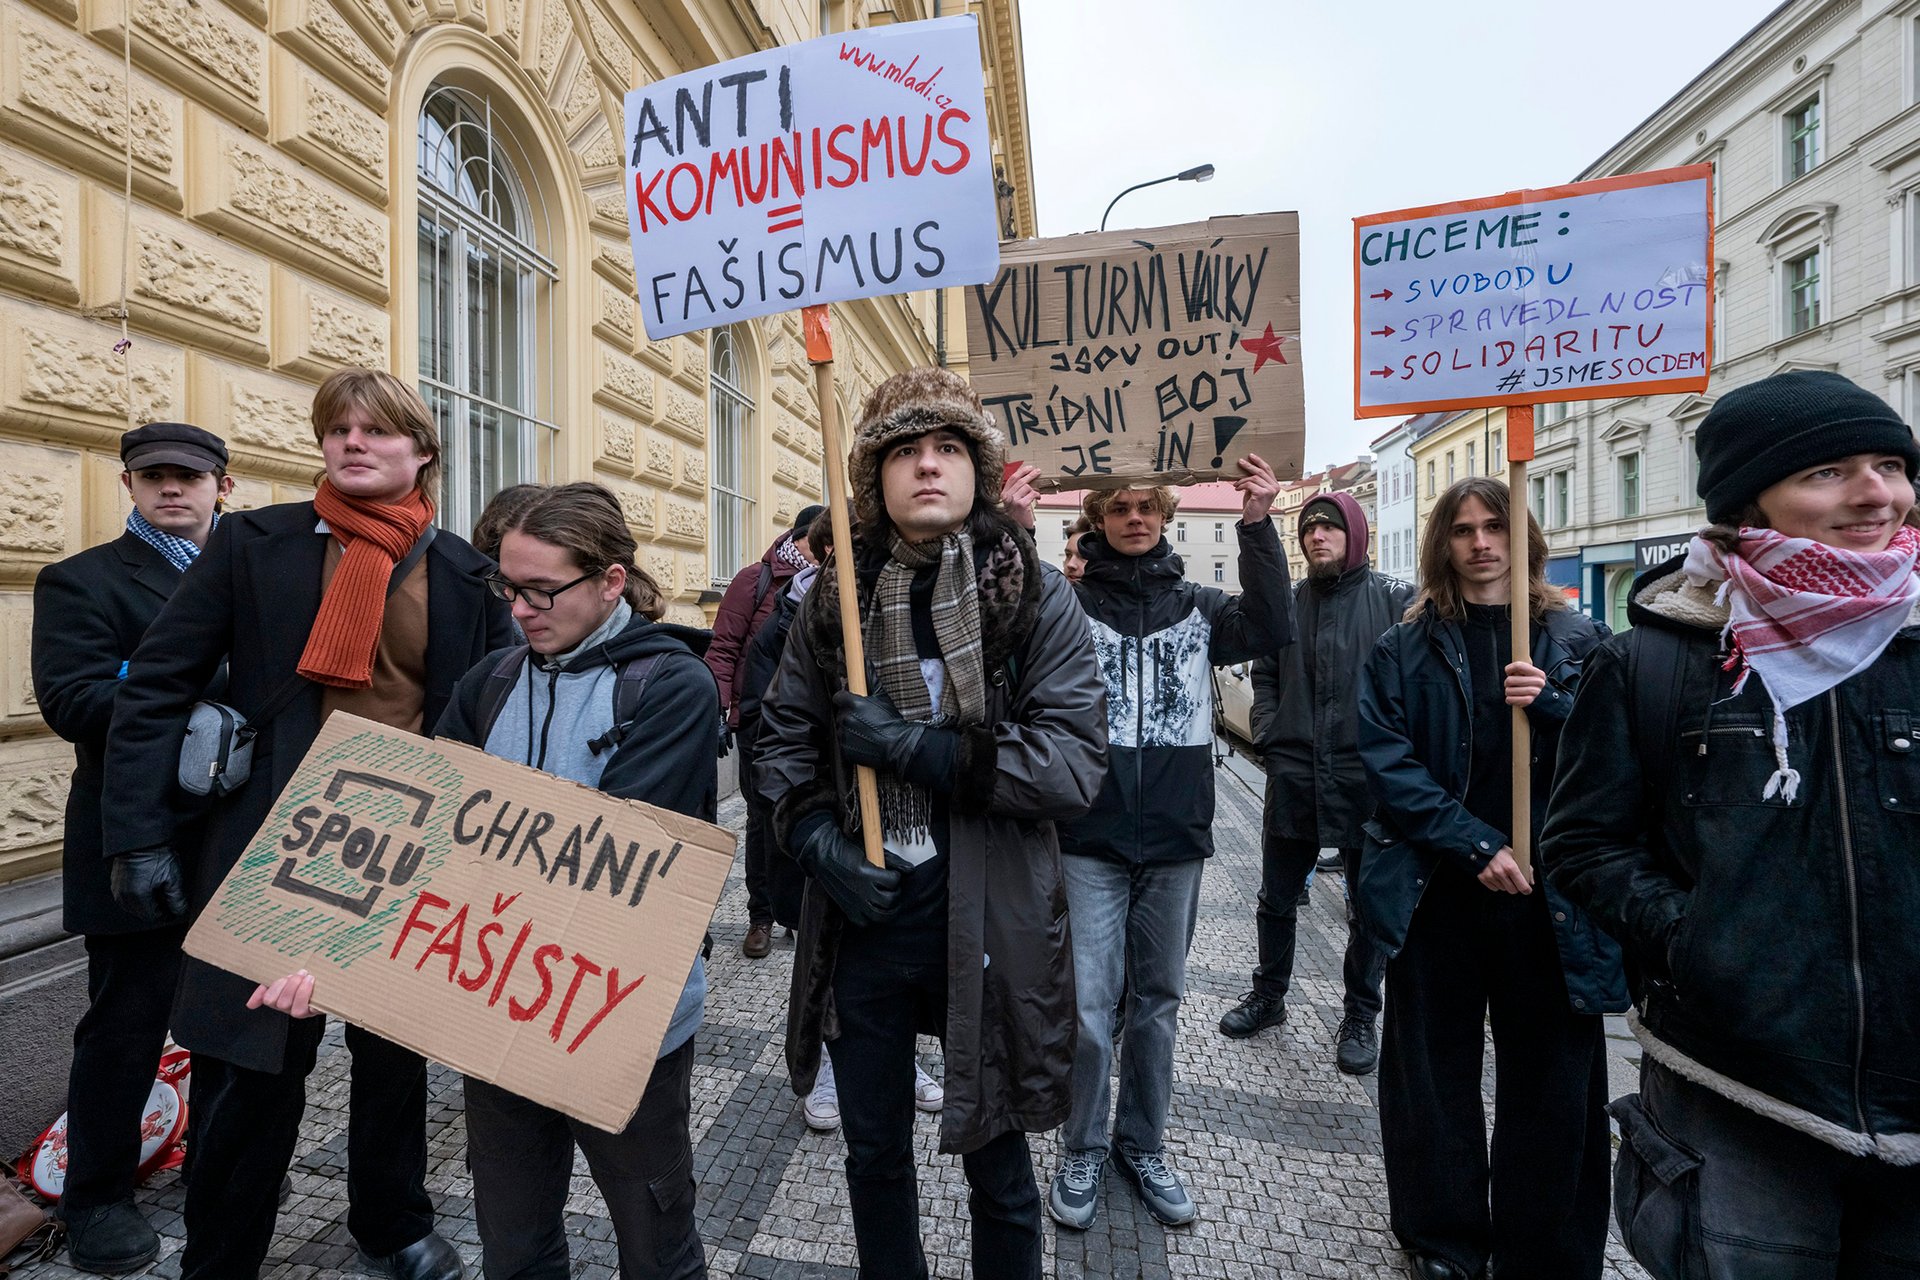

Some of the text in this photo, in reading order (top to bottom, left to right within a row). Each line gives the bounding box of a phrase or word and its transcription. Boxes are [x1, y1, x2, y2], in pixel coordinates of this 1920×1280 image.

[839, 42, 952, 109] www.mladi.cz
[632, 65, 792, 167] ANTI
[635, 108, 971, 232] KOMUNISMUS
[653, 221, 945, 323] FAŠISMUS
[1178, 237, 1268, 327] VÁLKY
[1405, 262, 1573, 302] SVOBODU
[1157, 330, 1240, 361] OUT!
[1401, 283, 1706, 342] SPRAVEDLNOST
[1401, 323, 1664, 381] SOLIDARITU
[981, 367, 1251, 446] TŘÍDNÍ BOJ
[1496, 351, 1705, 393] #JSMESOCDEM
[1060, 439, 1112, 477] JE
[282, 805, 425, 887] SPOLU
[453, 789, 683, 908] CHRÁNÍ
[390, 890, 647, 1054] FAŠISTY
